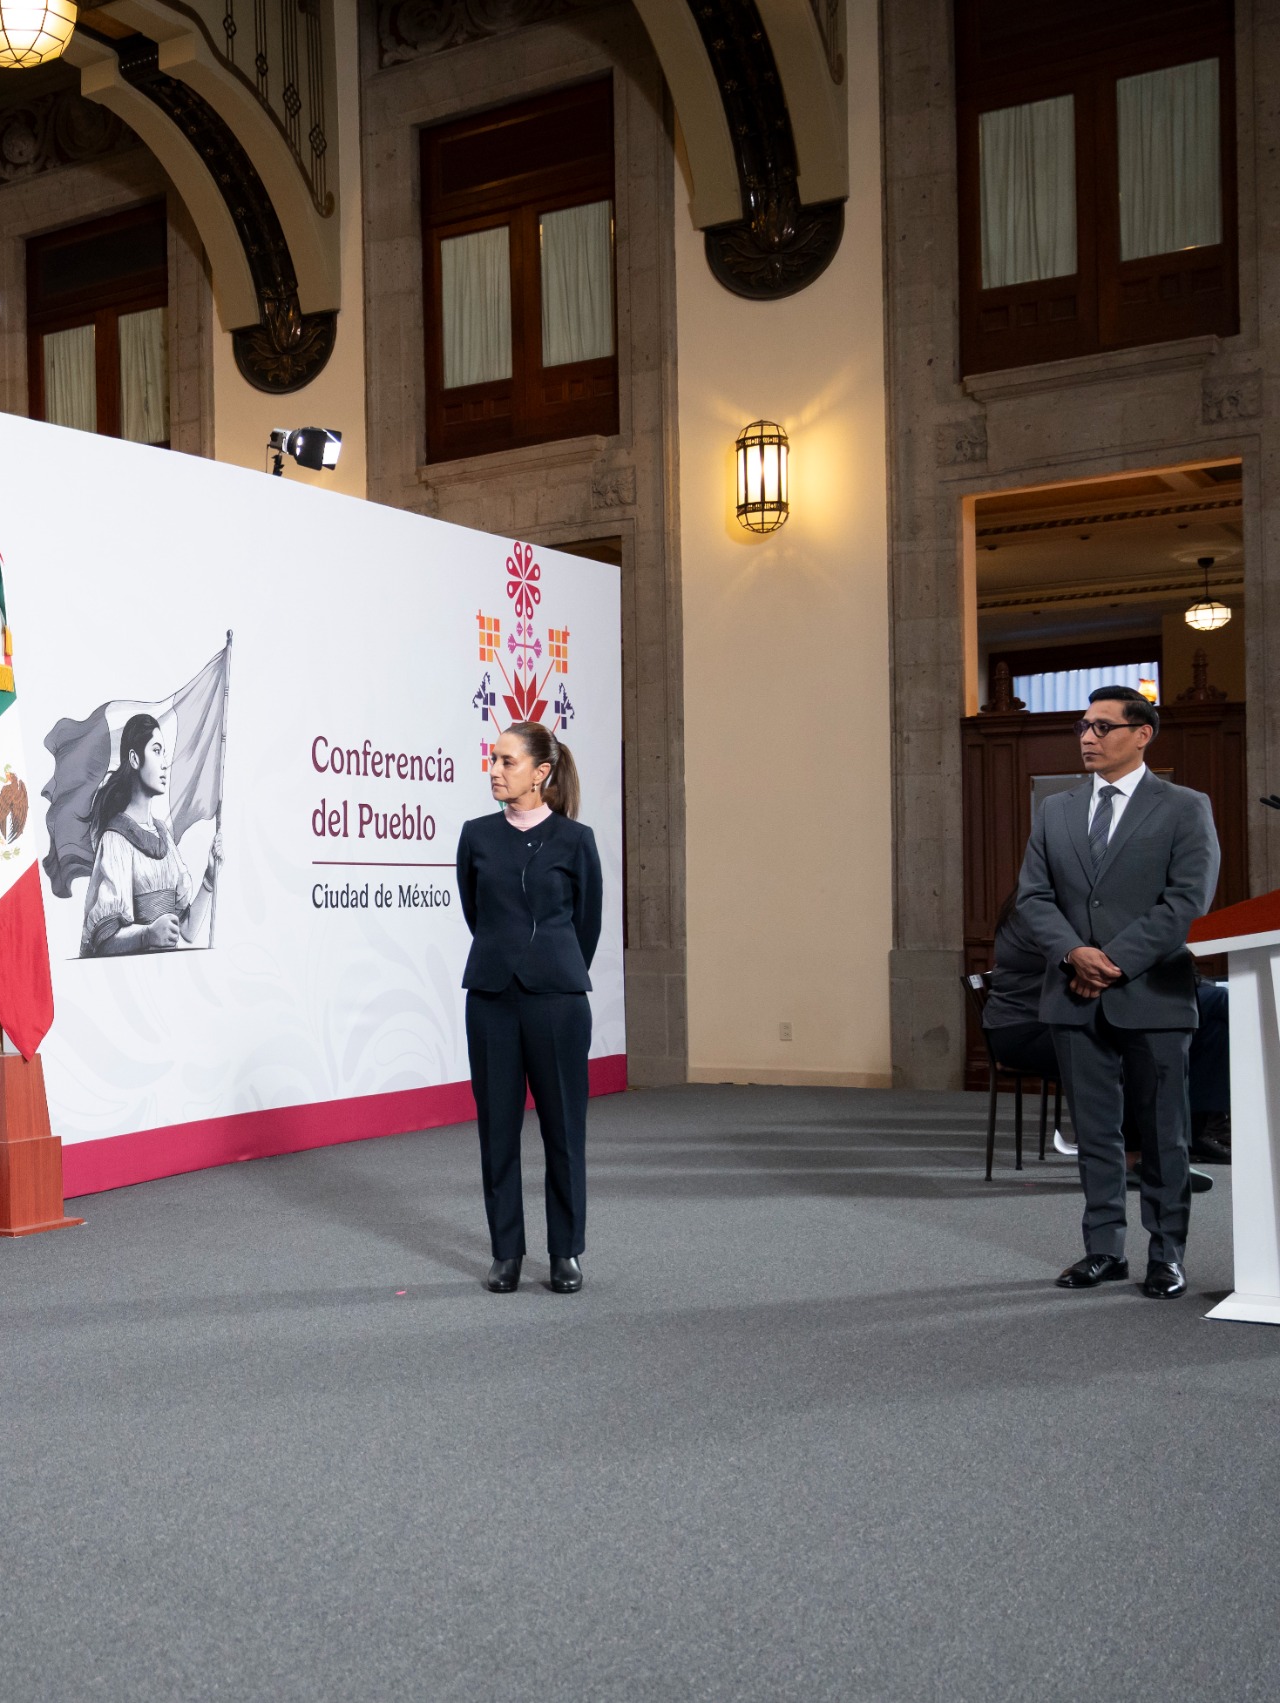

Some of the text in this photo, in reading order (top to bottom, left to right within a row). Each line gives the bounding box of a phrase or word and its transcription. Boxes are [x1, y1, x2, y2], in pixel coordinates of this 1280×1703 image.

[312, 736, 455, 783] Conferencia
[312, 798, 436, 841] del Pueblo
[312, 883, 451, 909] Ciudad de México
